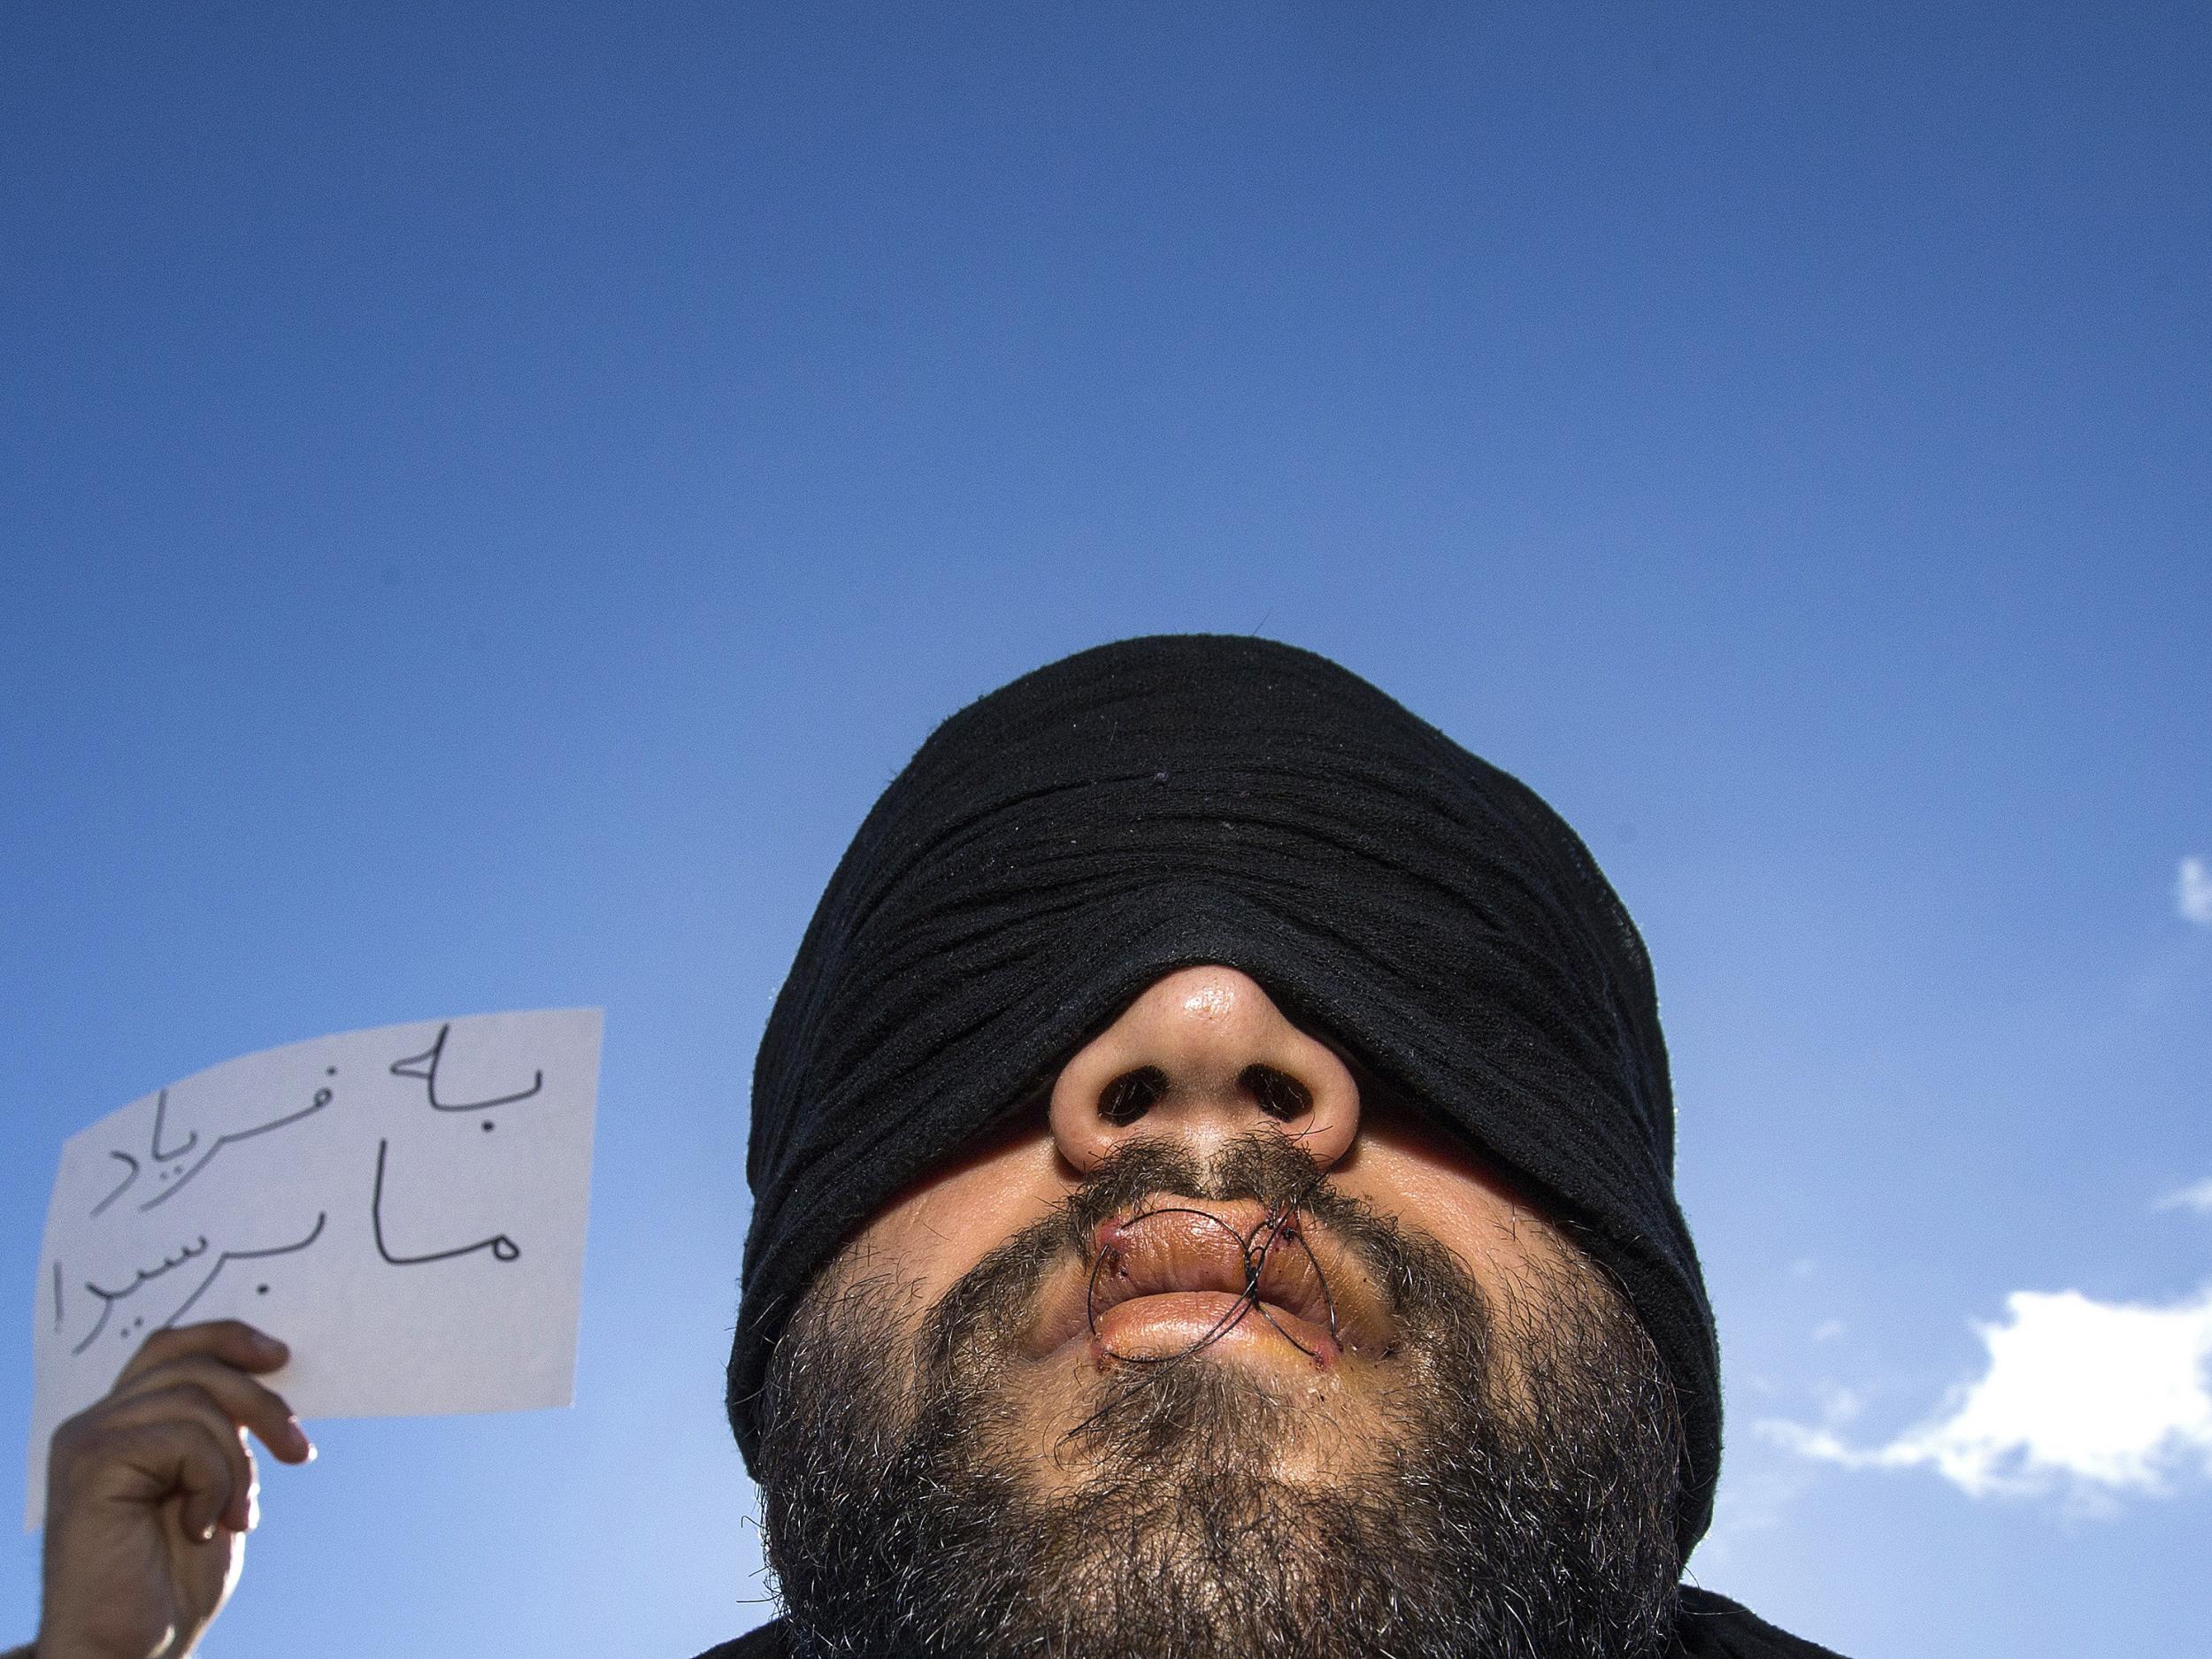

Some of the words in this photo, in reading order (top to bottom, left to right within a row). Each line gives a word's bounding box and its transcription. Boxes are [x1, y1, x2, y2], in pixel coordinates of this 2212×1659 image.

[89, 1065, 338, 1217] فریاد
[389, 1023, 542, 1132] به
[372, 1138, 520, 1265] ما
